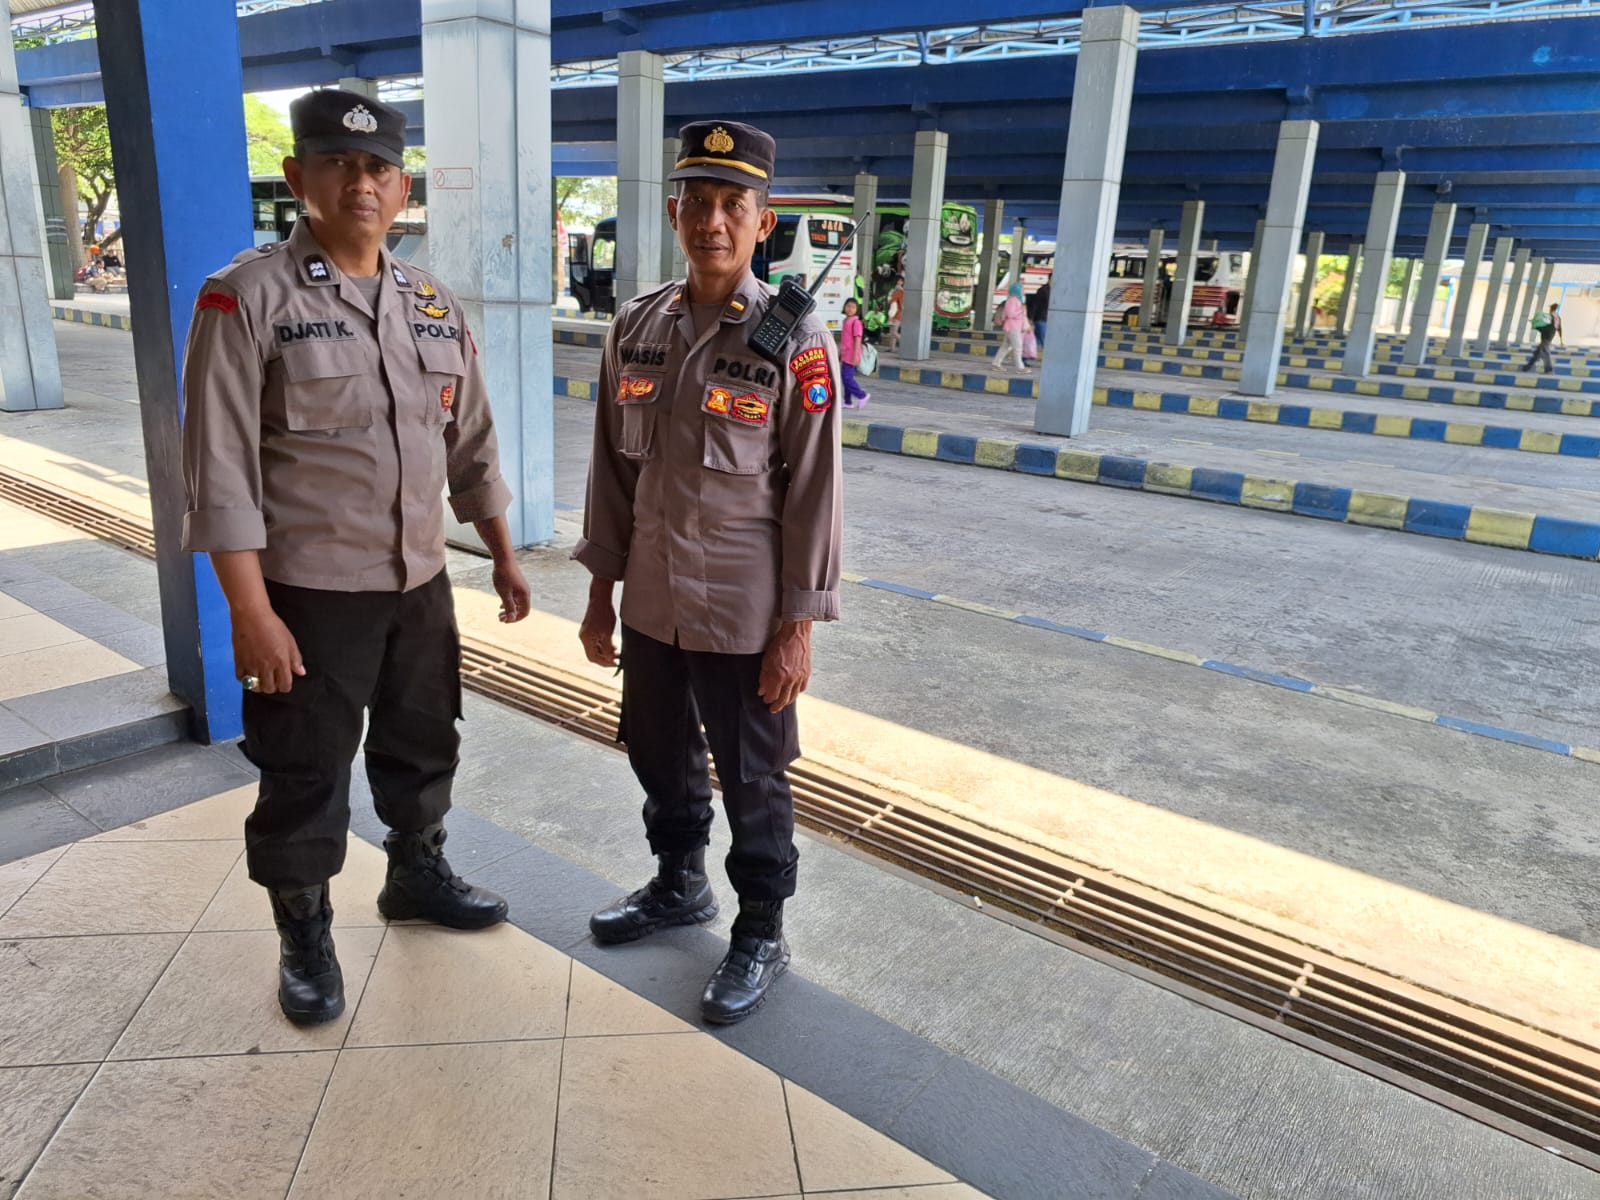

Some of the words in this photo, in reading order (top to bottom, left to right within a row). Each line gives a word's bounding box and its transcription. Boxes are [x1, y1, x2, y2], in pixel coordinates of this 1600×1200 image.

[280, 322, 332, 342] DJATI
[335, 320, 354, 337] K.
[620, 347, 666, 366] WASIS
[714, 357, 776, 388] POLRI
